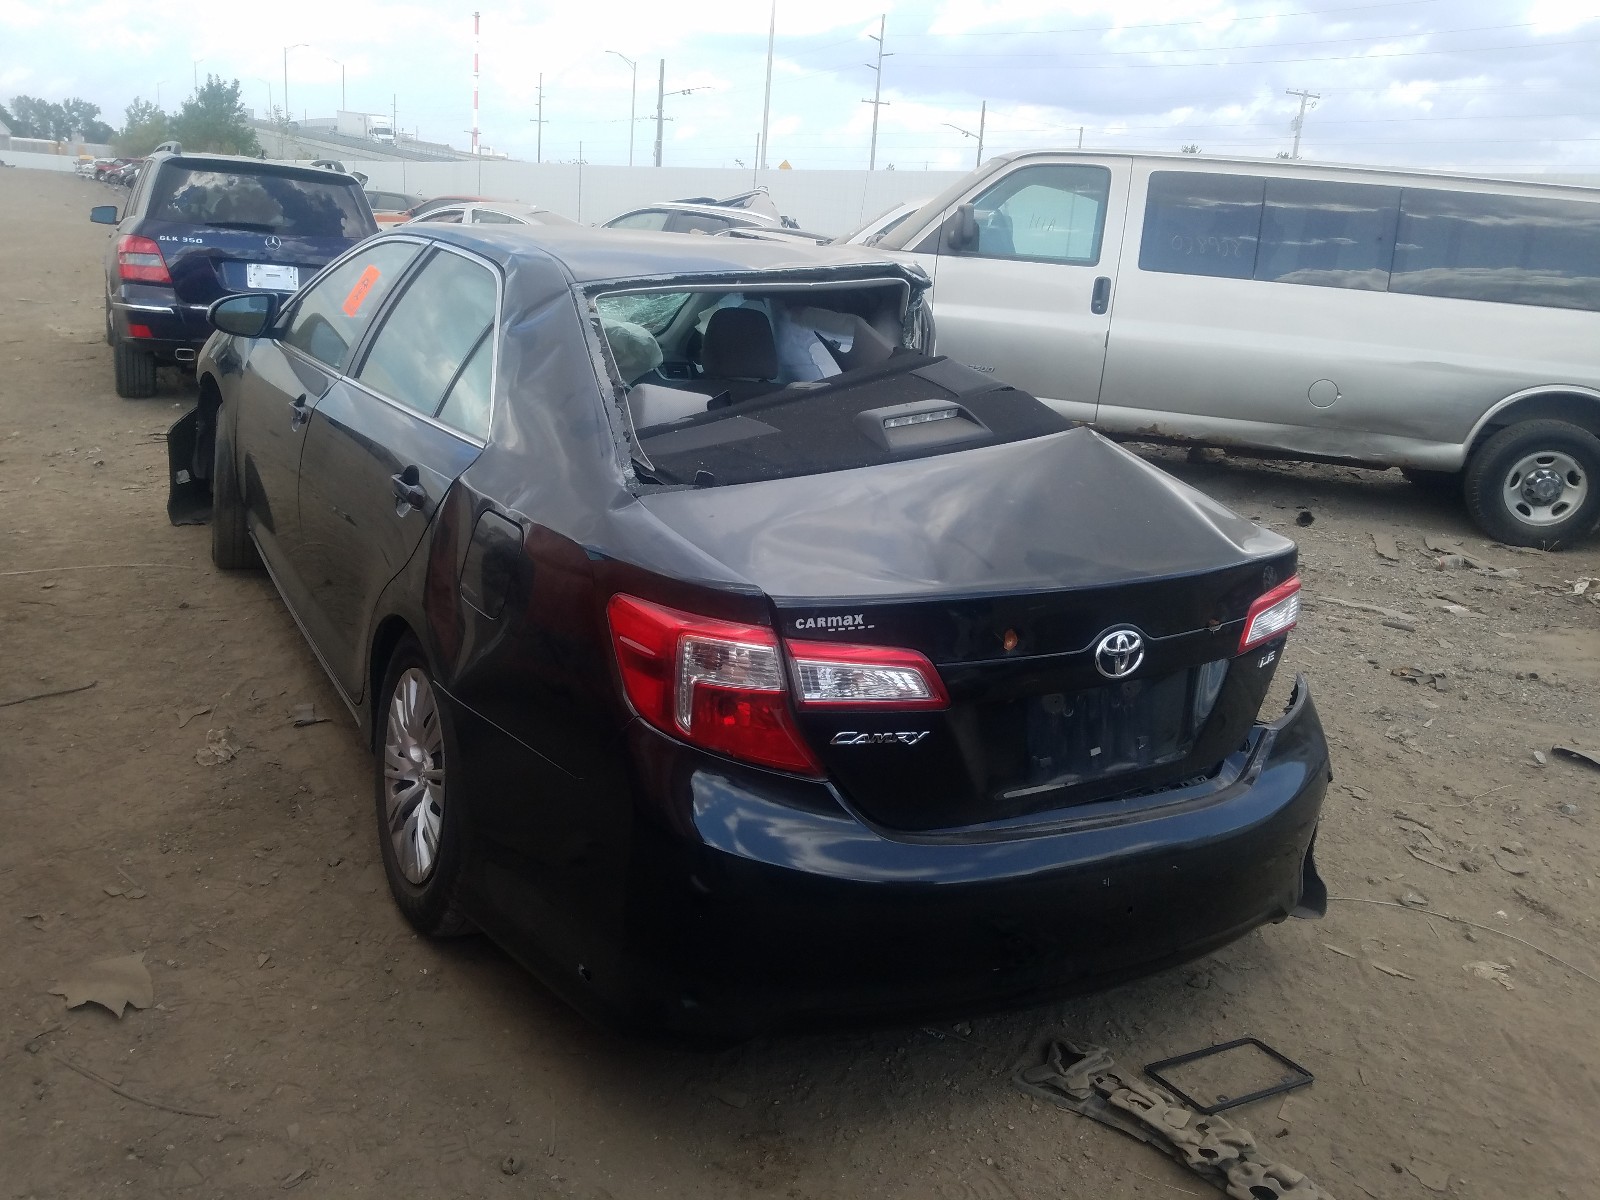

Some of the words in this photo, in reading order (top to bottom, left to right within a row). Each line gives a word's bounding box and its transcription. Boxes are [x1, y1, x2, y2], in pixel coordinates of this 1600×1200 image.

[182, 236, 203, 244] 350
[1257, 650, 1276, 669] LE
[829, 731, 930, 745] CAMRY
